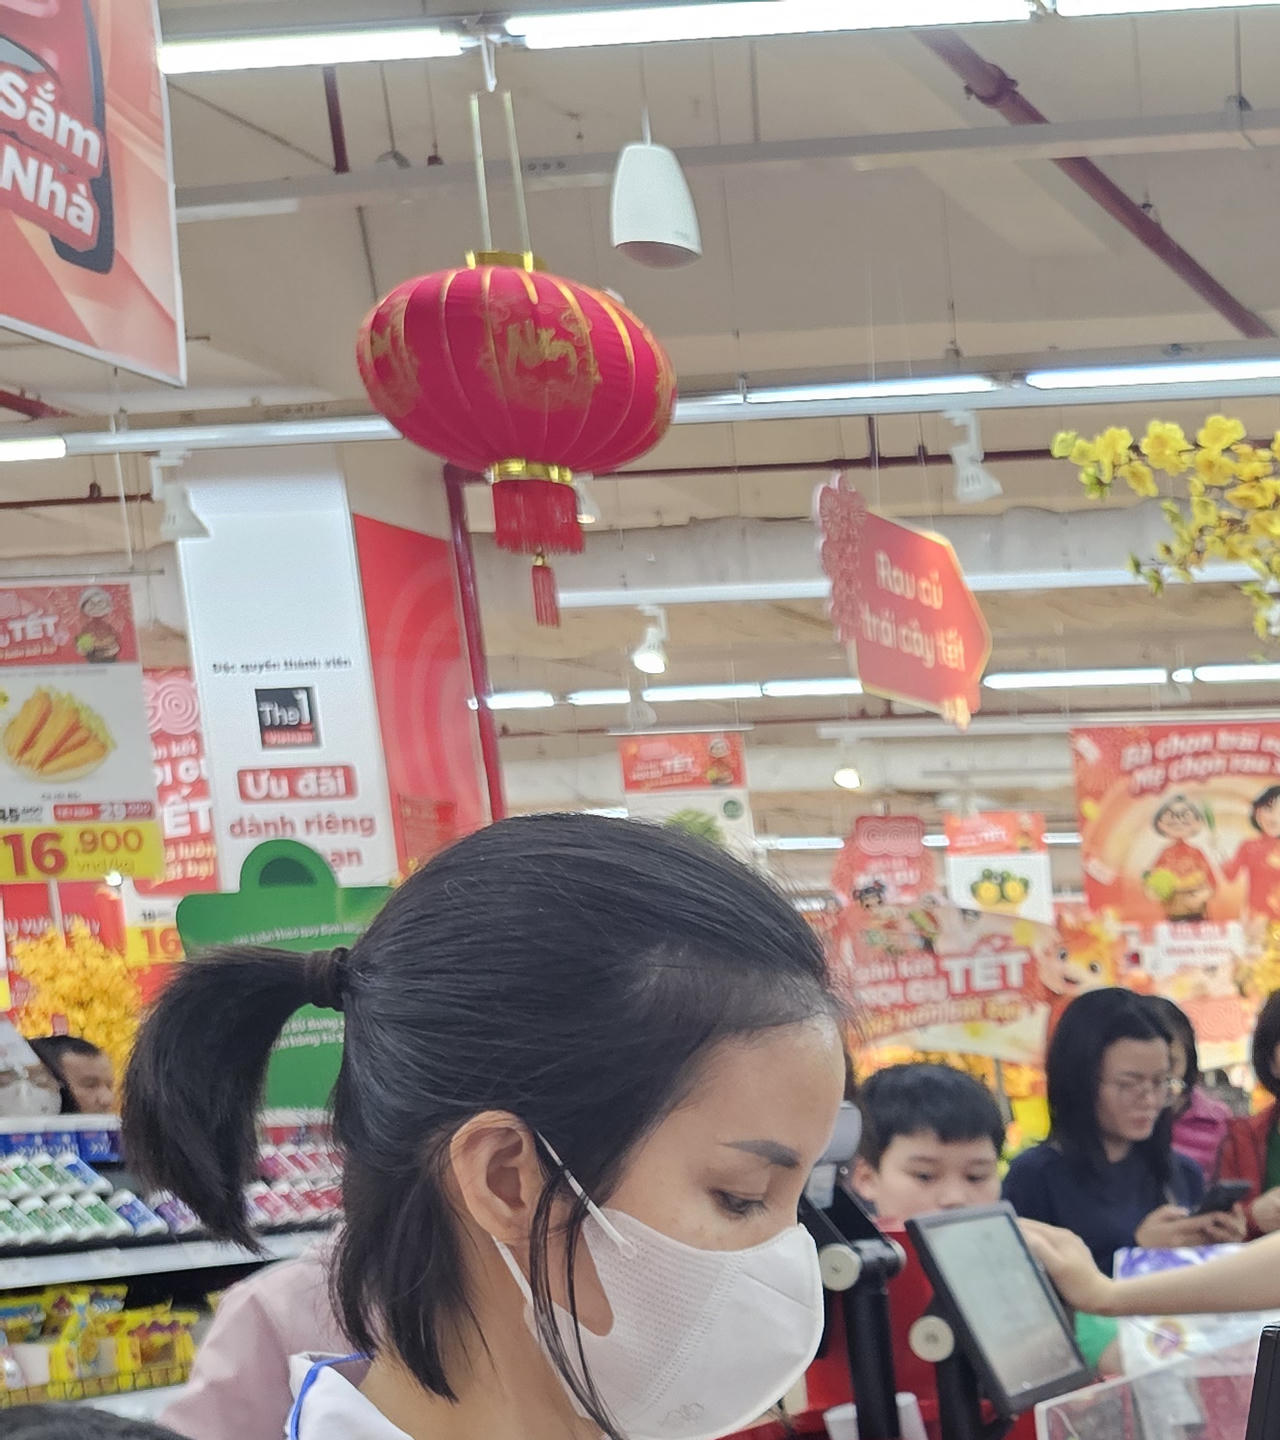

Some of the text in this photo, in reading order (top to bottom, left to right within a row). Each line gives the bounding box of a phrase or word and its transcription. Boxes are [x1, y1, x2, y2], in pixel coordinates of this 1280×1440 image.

[0, 70, 100, 168] Sắm
[0, 144, 95, 236] Nhà
[876, 549, 915, 600] Rau
[9, 607, 59, 642] TẾT
[246, 766, 347, 800] Ưu đãi
[163, 786, 214, 839] ẾT
[229, 812, 377, 838] dành riêng
[3, 830, 69, 877] 16
[329, 848, 363, 875] ạn
[141, 928, 180, 957] 16
[941, 945, 1030, 995] TẾT
